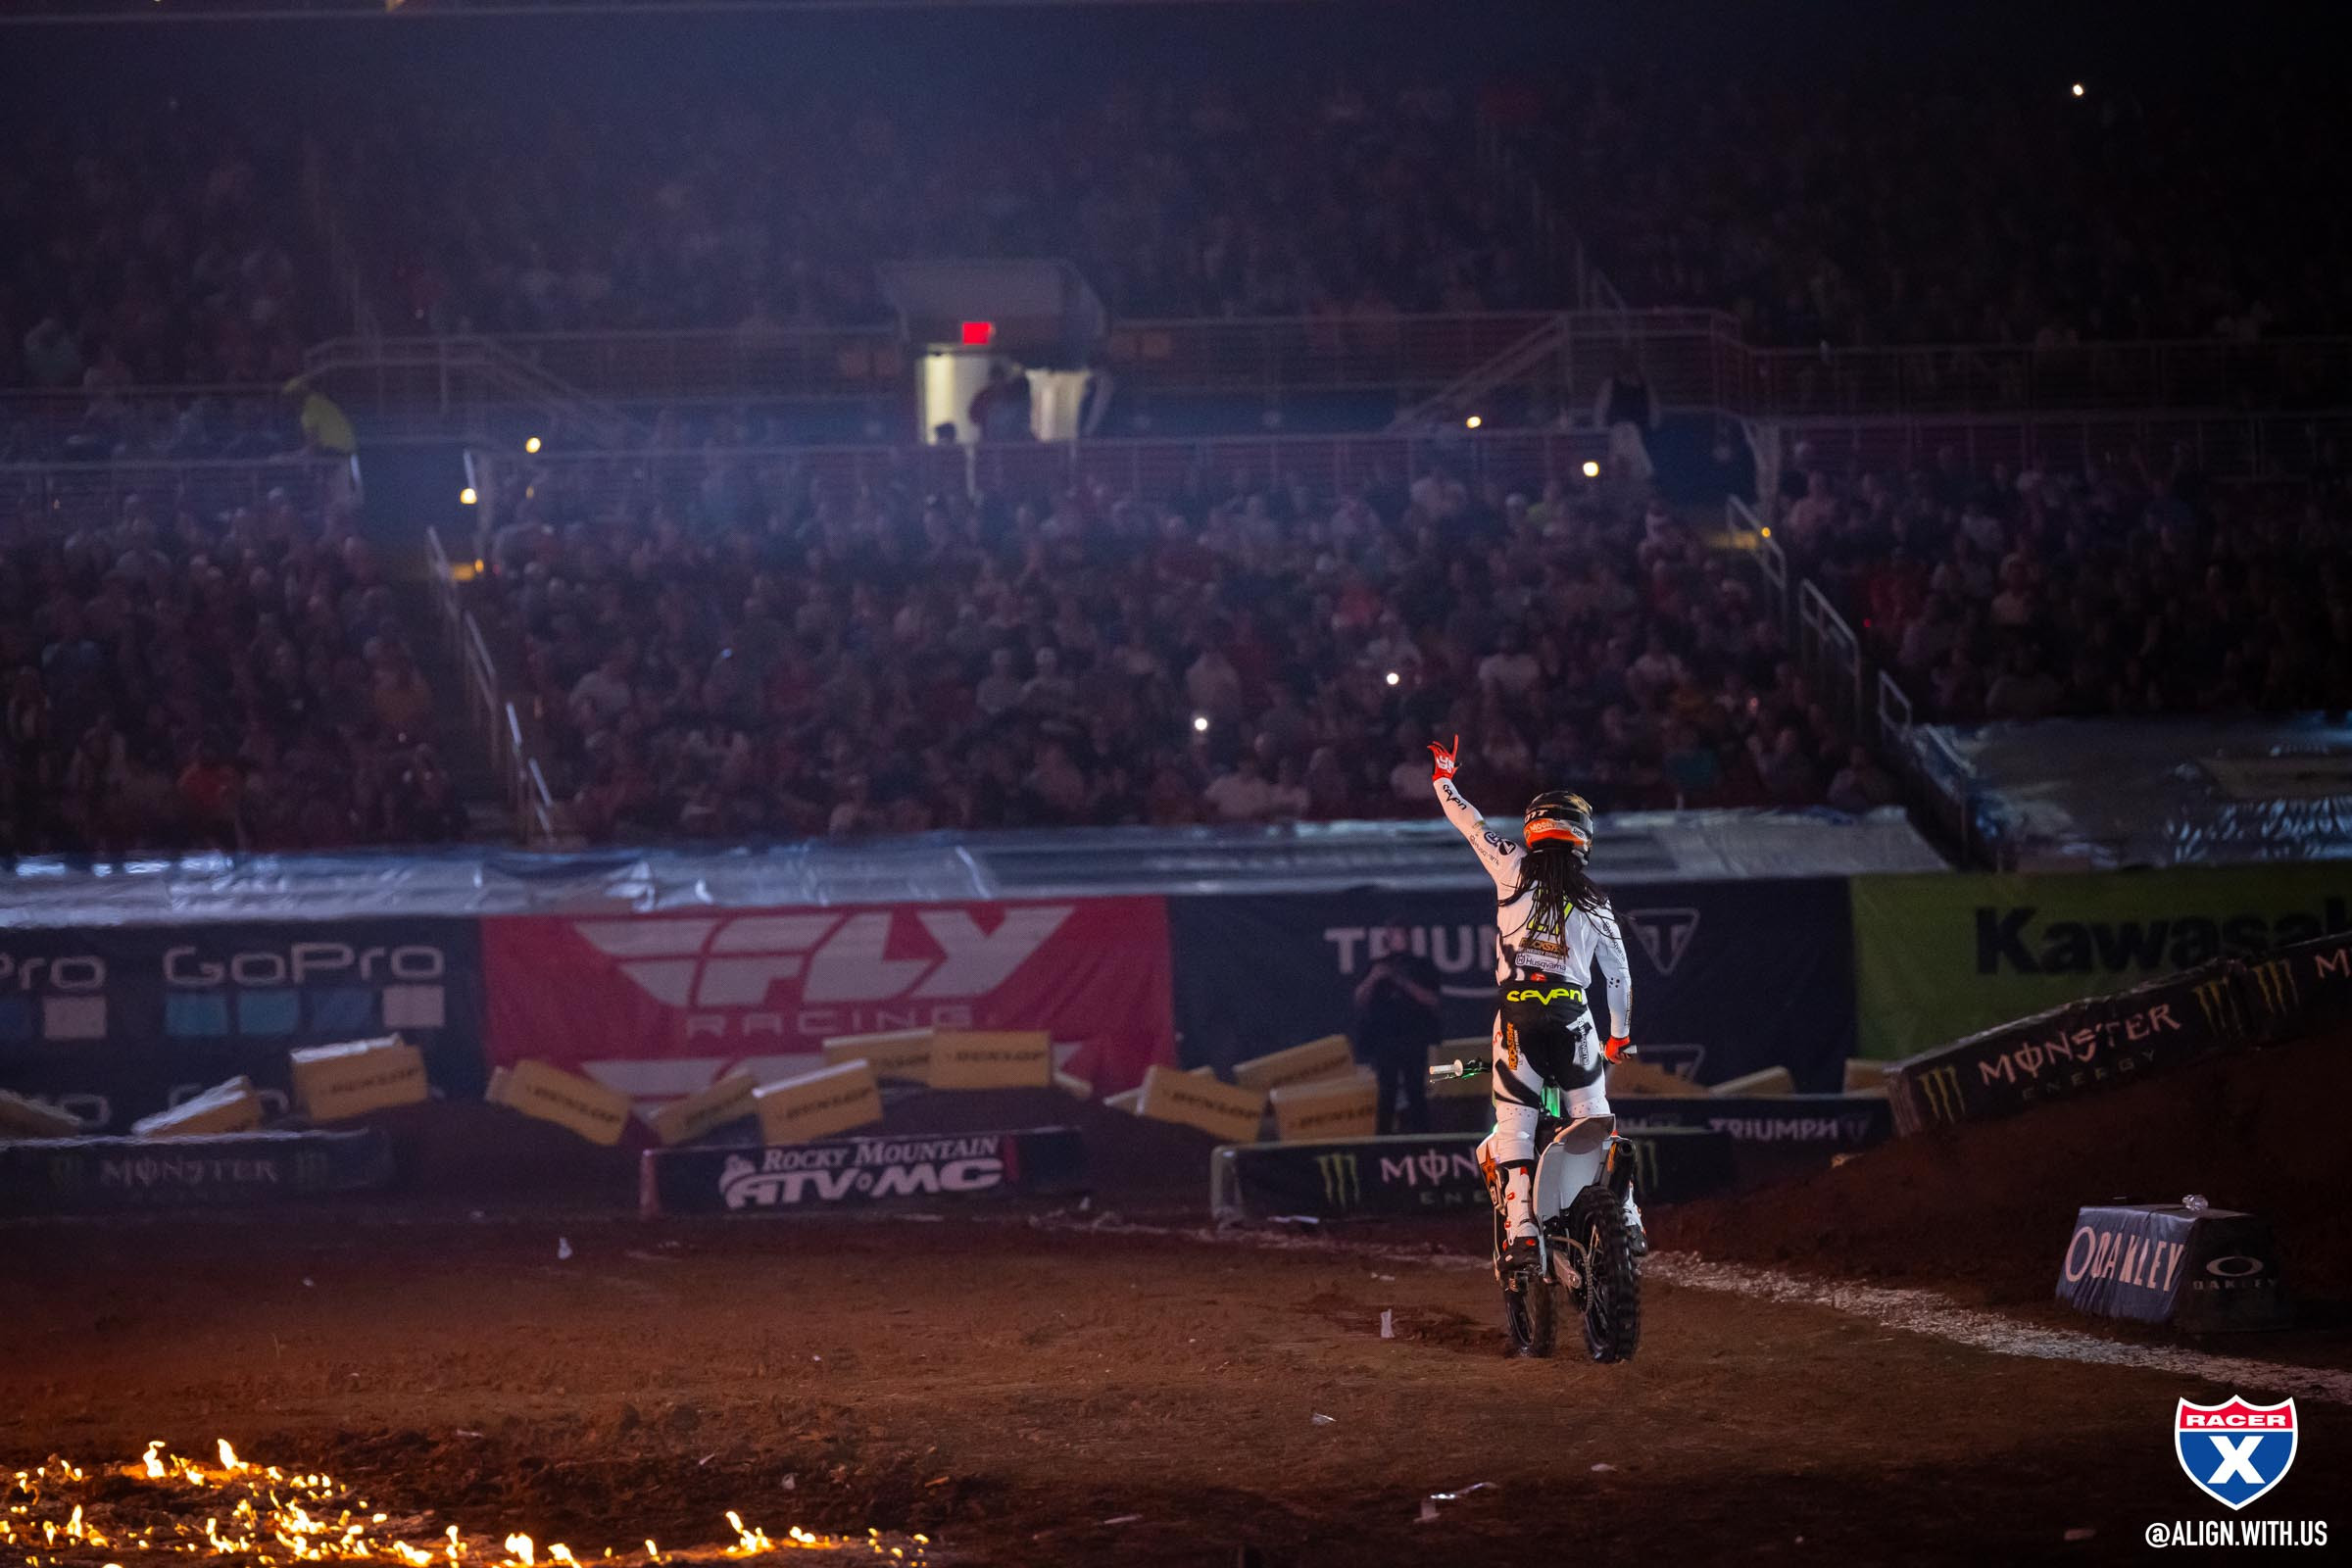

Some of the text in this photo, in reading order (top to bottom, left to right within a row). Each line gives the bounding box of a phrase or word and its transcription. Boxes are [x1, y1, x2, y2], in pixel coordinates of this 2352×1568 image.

[163, 941, 446, 987] GoPro
[574, 905, 1076, 1008] FLY
[762, 1135, 1000, 1171] ROCKY MOUNTAIN
